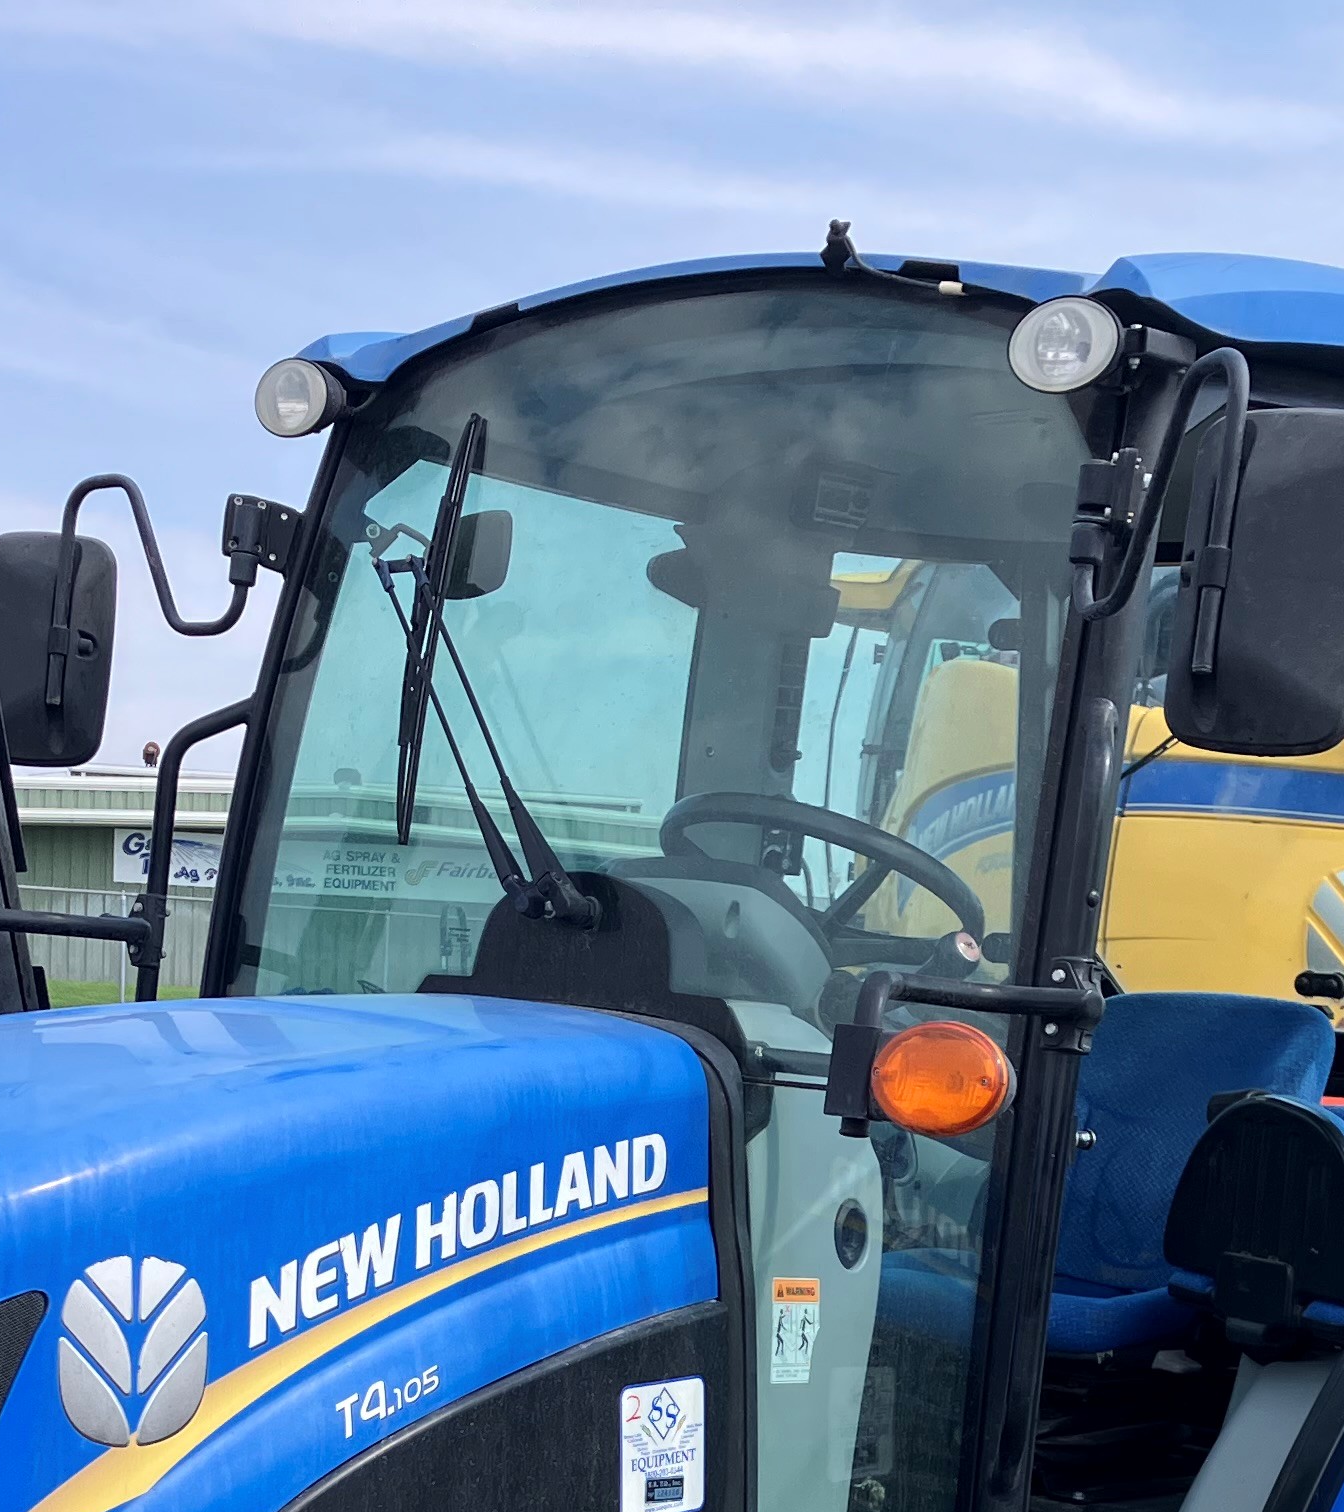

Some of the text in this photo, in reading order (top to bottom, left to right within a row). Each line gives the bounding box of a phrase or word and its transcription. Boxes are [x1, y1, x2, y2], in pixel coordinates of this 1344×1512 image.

[346, 850, 385, 864] SPRAY
[326, 863, 396, 878] FERTILIZER
[323, 877, 396, 892] EQUIPMENT
[248, 1132, 668, 1349] NEW HOLLAND
[785, 1286, 816, 1297] WARNING
[335, 1364, 440, 1439] T4.105
[630, 1447, 697, 1473] EQUIPMENT
